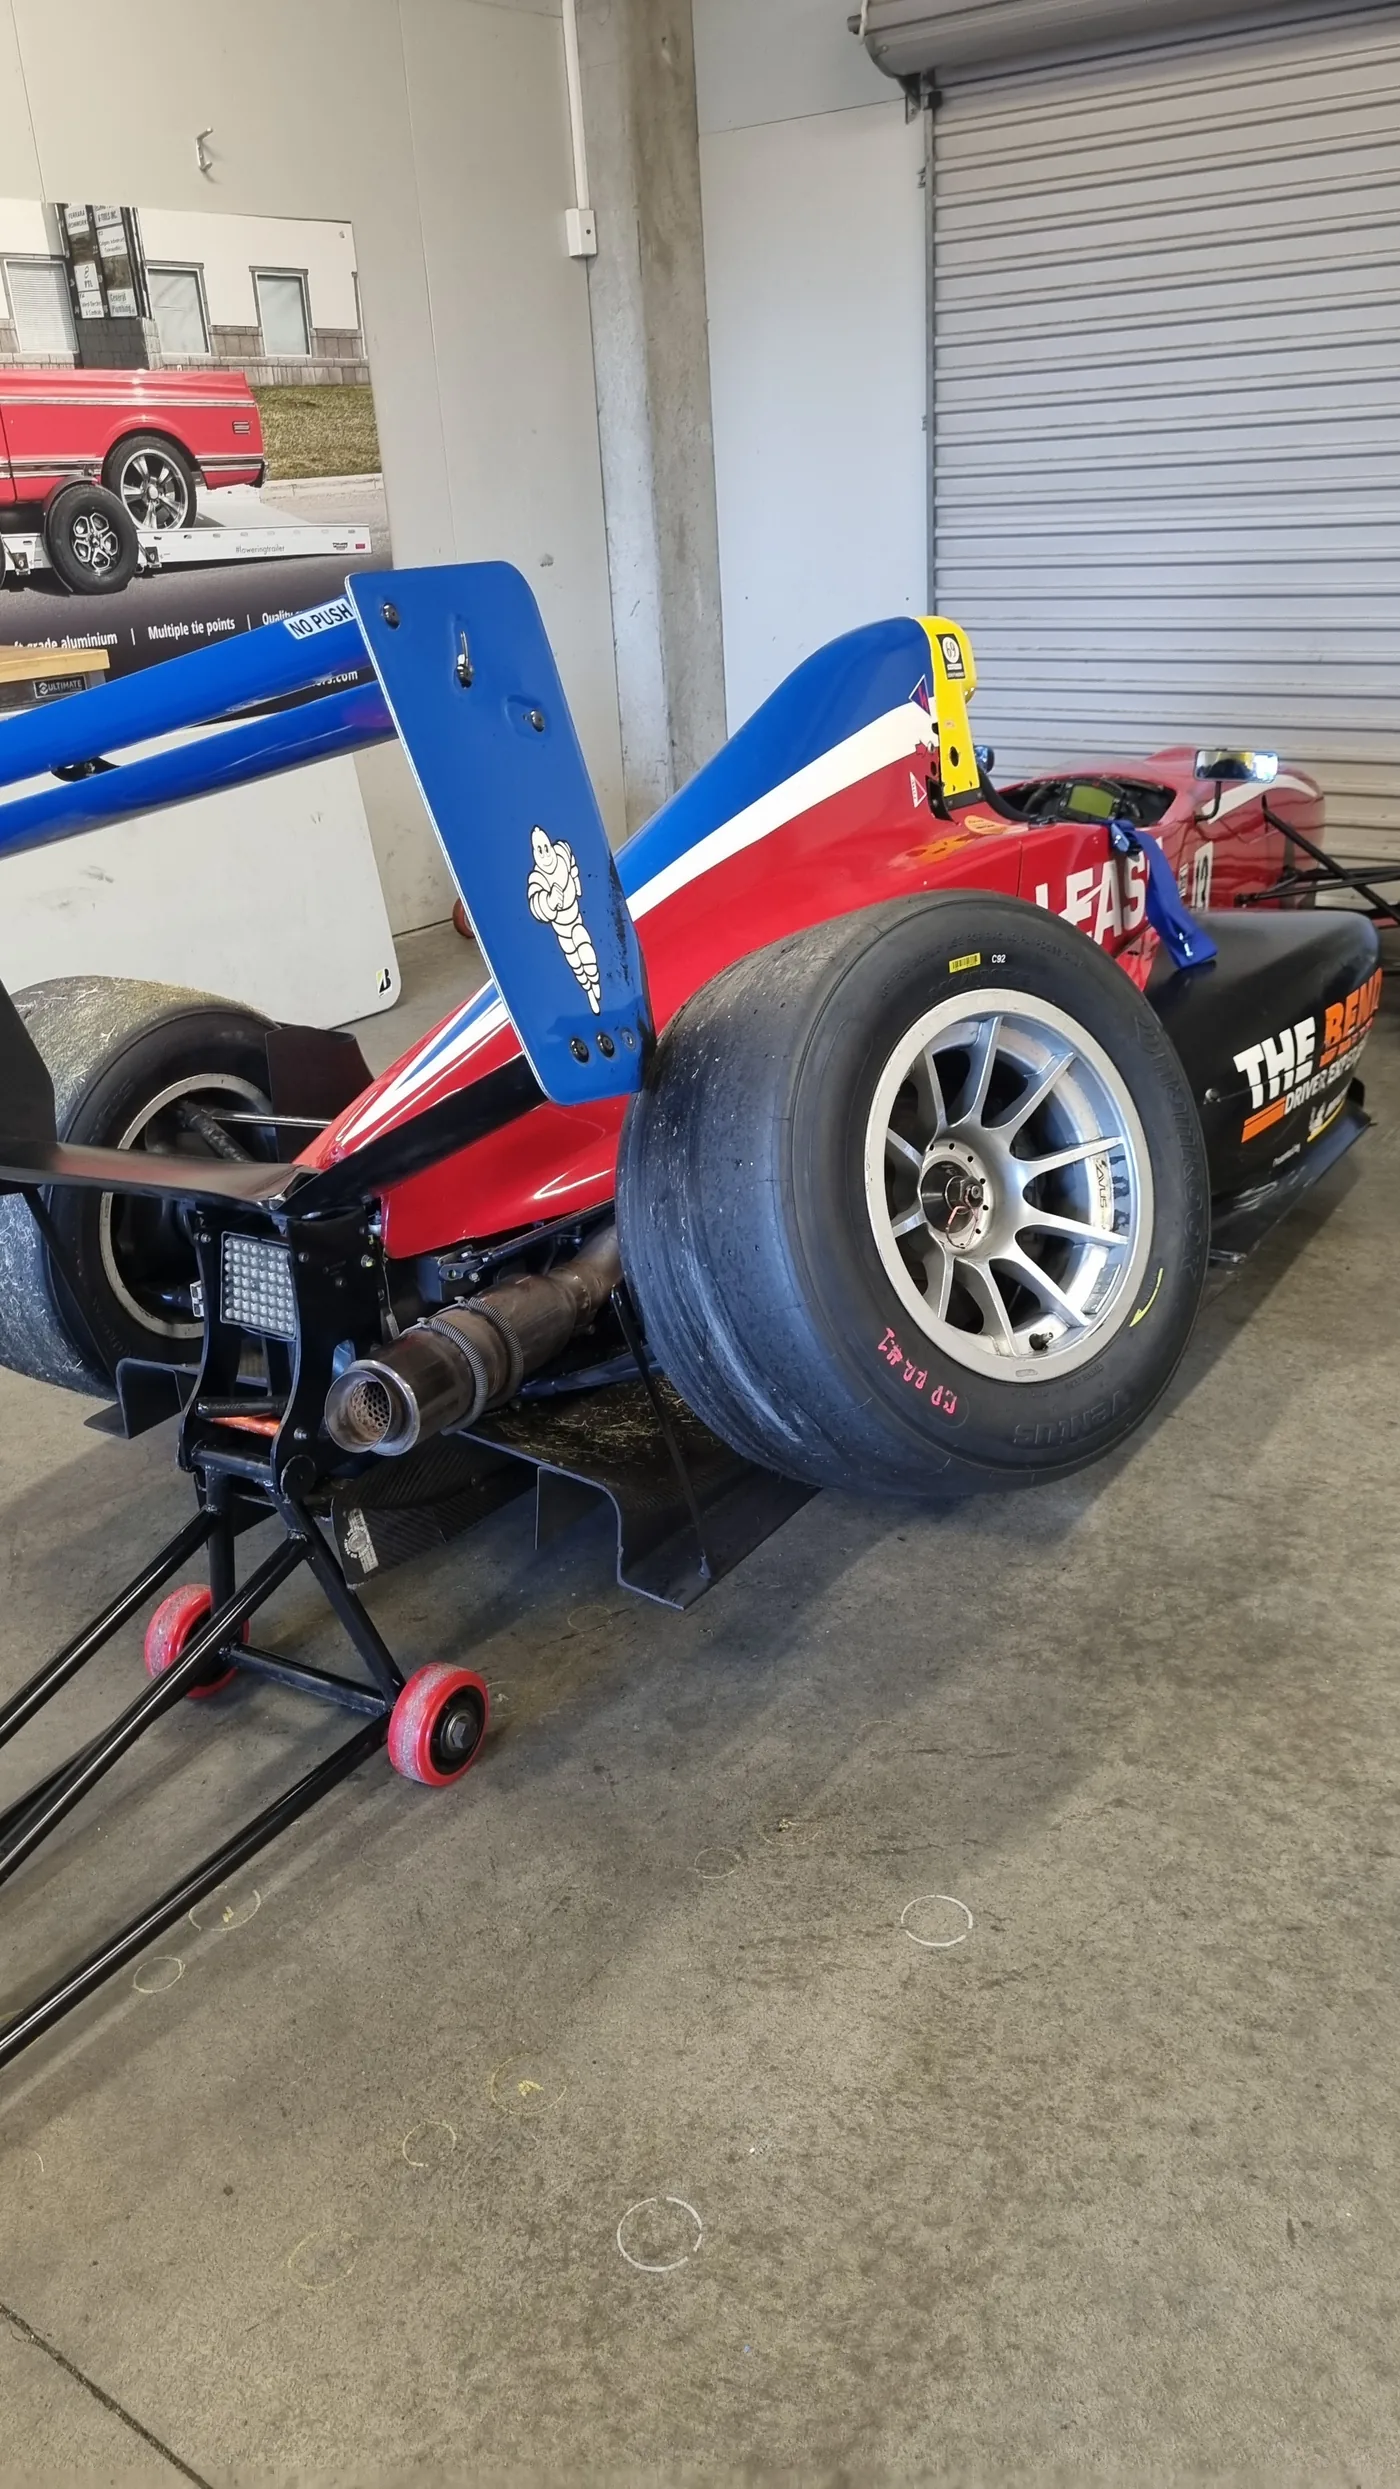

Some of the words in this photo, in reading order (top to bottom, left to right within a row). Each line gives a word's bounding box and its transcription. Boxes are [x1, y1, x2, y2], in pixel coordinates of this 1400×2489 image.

[60, 632, 118, 649] aluminium
[147, 622, 189, 640] Multiple
[190, 620, 205, 635] tie
[206, 617, 236, 636] points
[288, 619, 314, 637] NO
[309, 603, 354, 629] PUSH
[47, 680, 82, 692] ULTIMATE
[991, 953, 1006, 964] C92
[1233, 1016, 1316, 1110] THE
[1319, 967, 1383, 1068] BEND
[1284, 1069, 1328, 1116] DRIVER
[1095, 1164, 1108, 1209] AVUS
